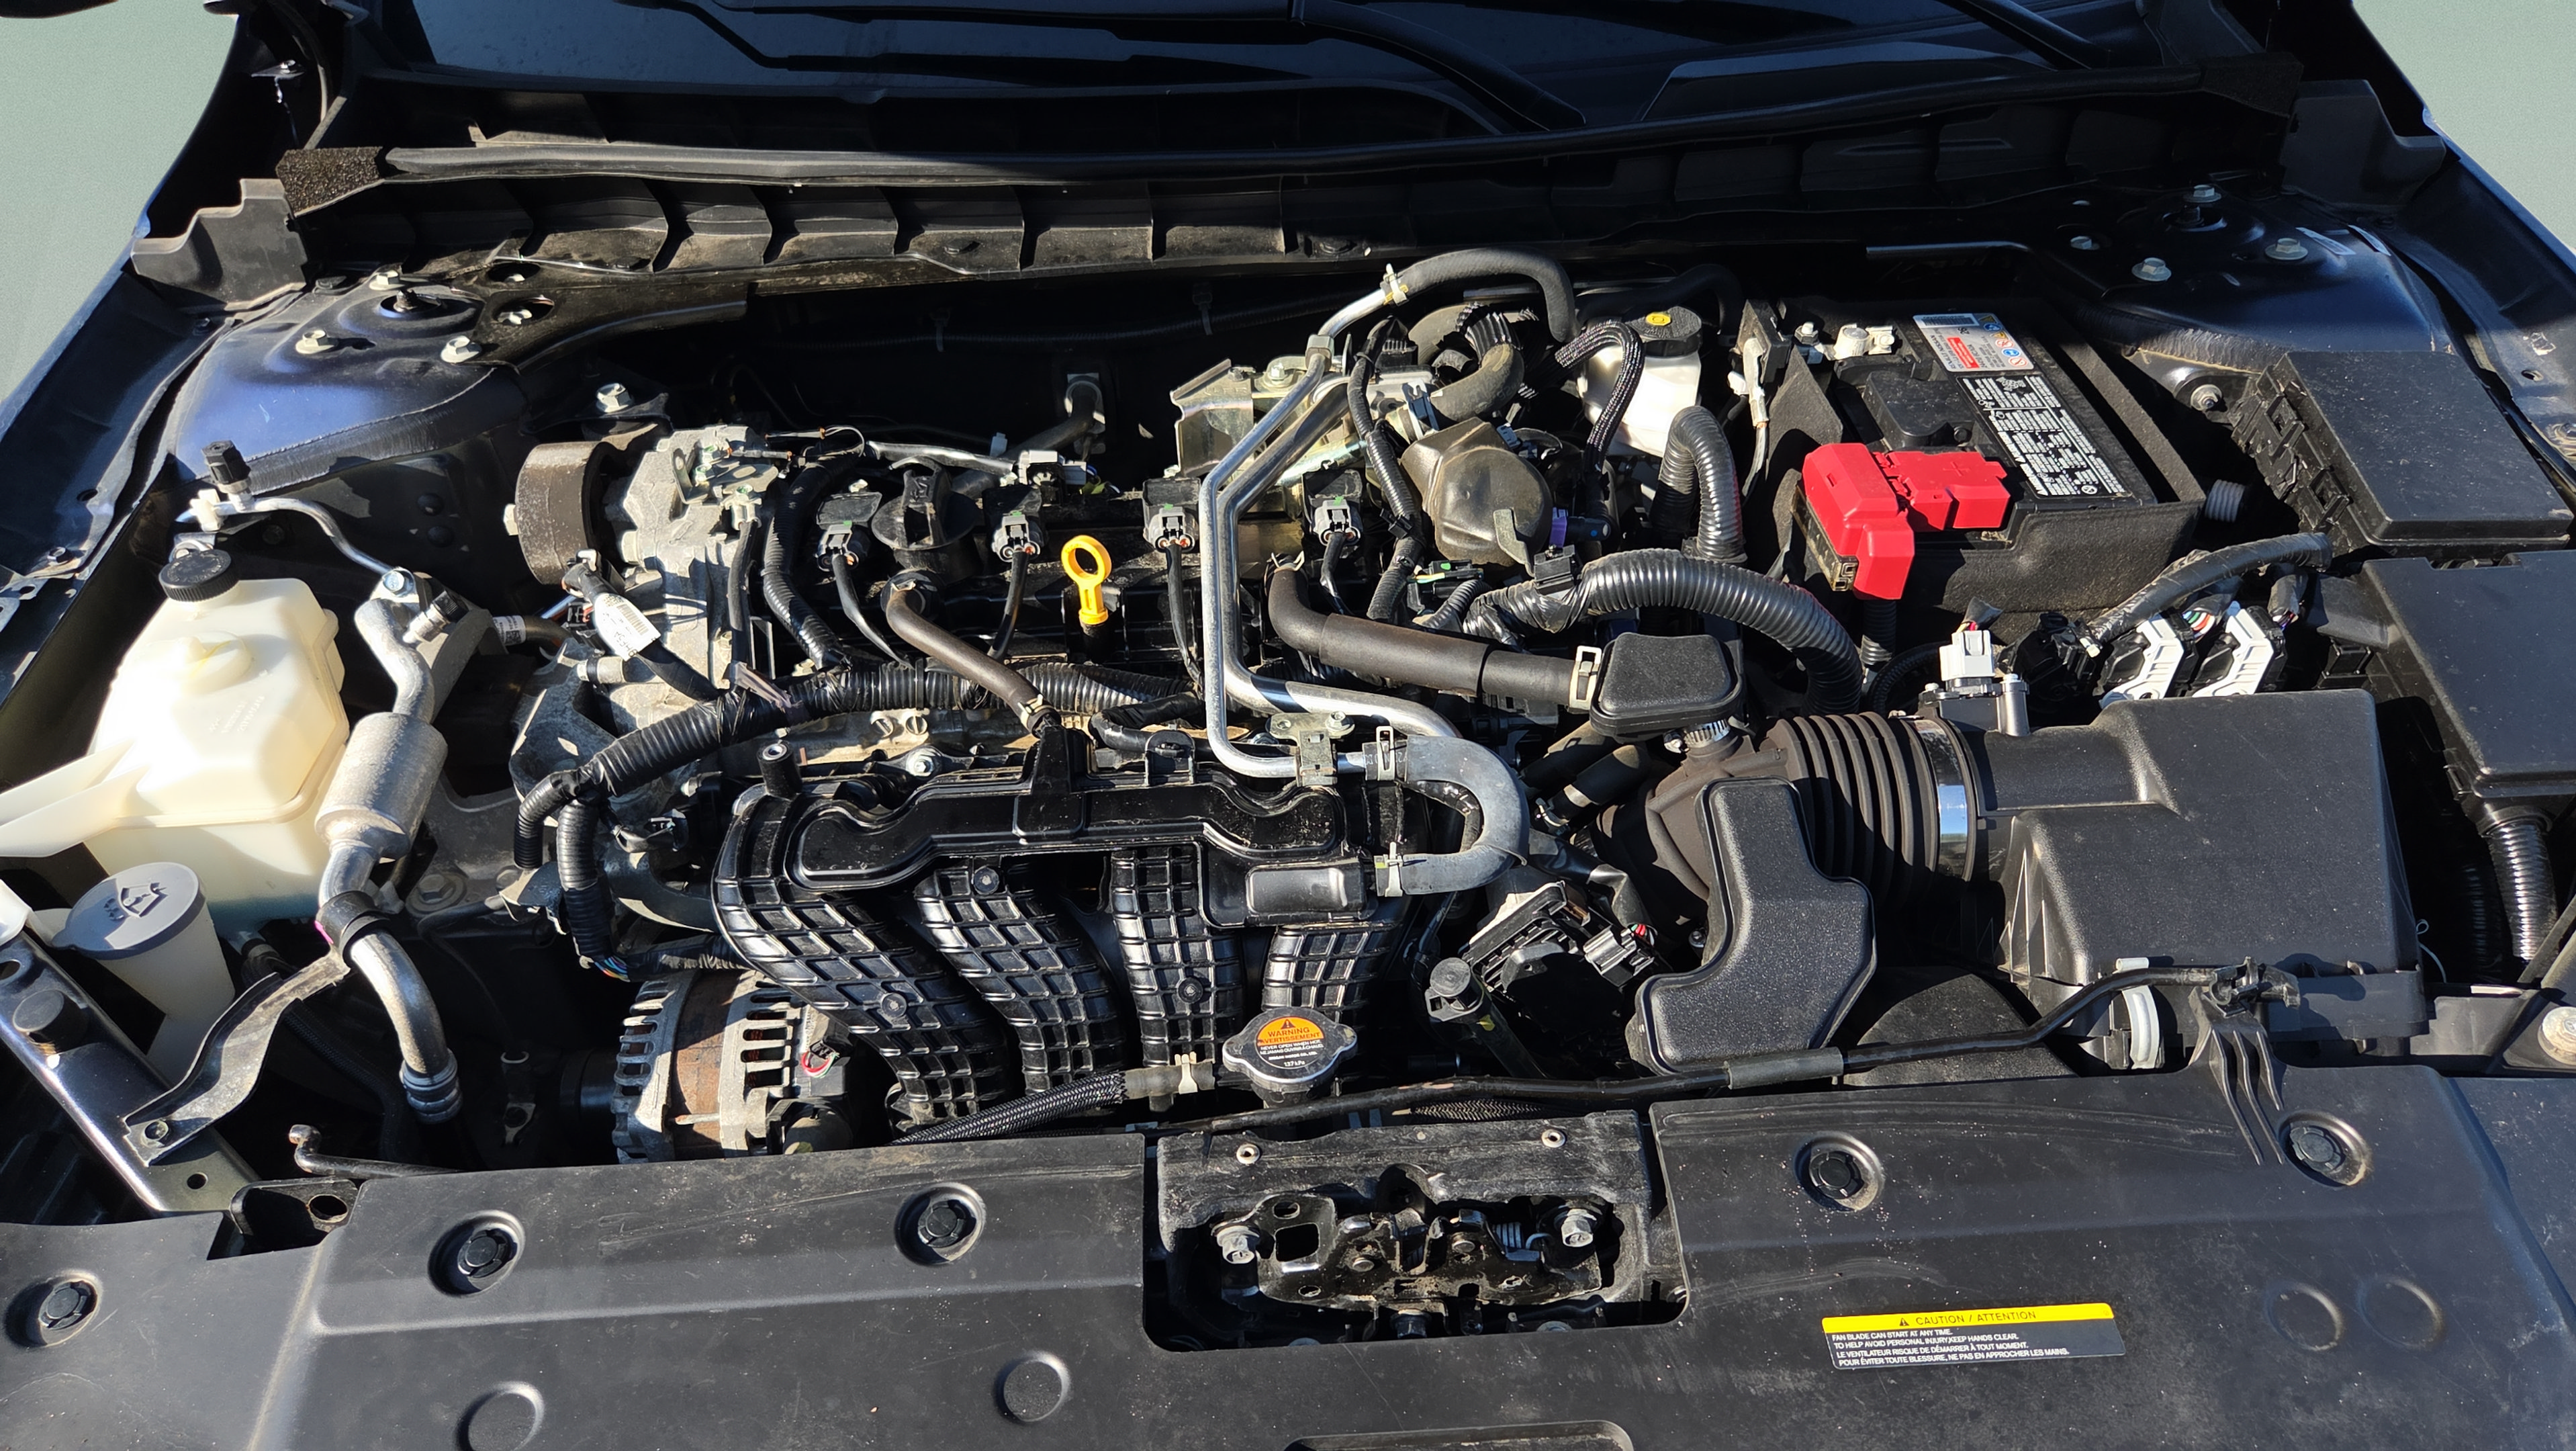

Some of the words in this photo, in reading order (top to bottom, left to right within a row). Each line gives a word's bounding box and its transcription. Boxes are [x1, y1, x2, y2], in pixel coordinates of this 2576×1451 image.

[1268, 1026, 1309, 1037] WARNING
[1916, 1315, 1964, 1325] CAUTION
[1977, 1311, 2036, 1321] ATTENTION
[1847, 1333, 1870, 1341] BLADE
[1871, 1331, 1886, 1339] CAN
[1886, 1337, 1925, 1346] PERSONAL
[1968, 1333, 1993, 1342] HANDS
[1994, 1332, 2019, 1340] CLEAR.
[1846, 1349, 1891, 1358] VENTILATEUR
[1892, 1348, 1919, 1356] RISQUE
[1931, 1343, 1969, 1353] DÉMARRER
[1970, 1342, 1976, 1351] À
[1976, 1343, 1994, 1351] TOUT
[1996, 1341, 2029, 1350] MOMENT.
[1839, 1359, 1859, 1367] POUR
[1861, 1356, 1884, 1366] ÉVITER
[1884, 1356, 1908, 1364] TOUTE
[1908, 1354, 1947, 1364] BLESSURE,
[1986, 1350, 2030, 1359] APPROCHER
[2044, 1348, 2070, 1356] MAINS.
